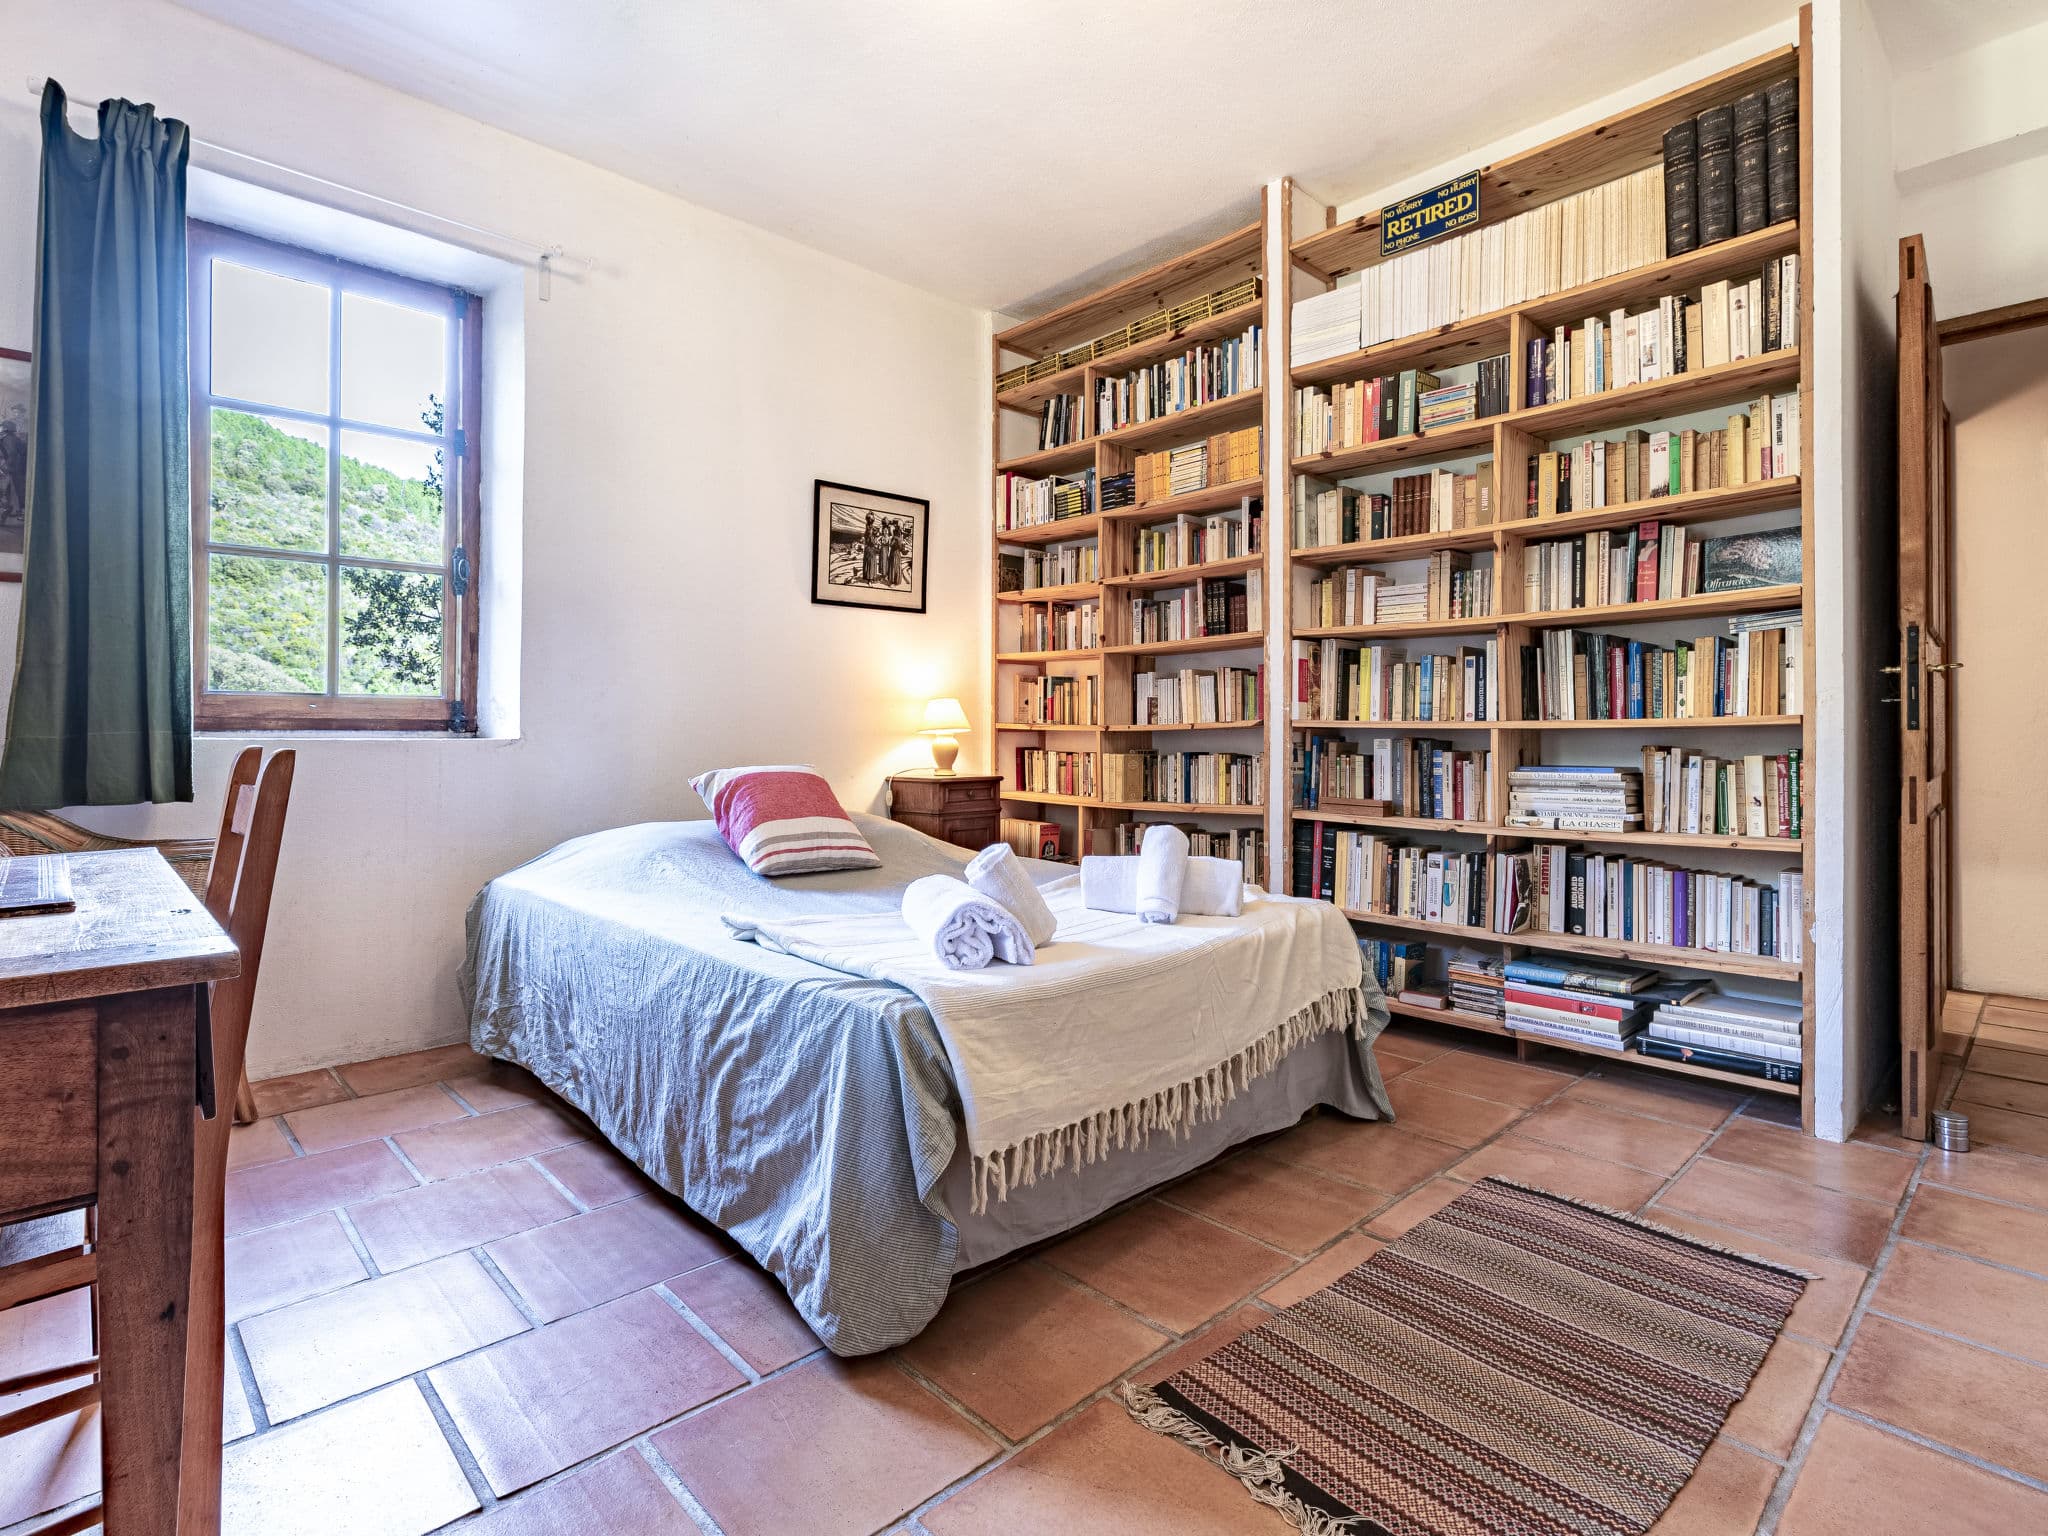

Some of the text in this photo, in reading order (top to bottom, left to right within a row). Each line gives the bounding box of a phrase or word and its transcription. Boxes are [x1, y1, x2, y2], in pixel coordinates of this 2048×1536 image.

[1437, 176, 1477, 199] NO HURRY
[1384, 199, 1423, 220] NO WORRY
[1386, 192, 1473, 239] RETIRED
[1445, 211, 1477, 229] NO BOSS
[1384, 232, 1421, 250] NO PHONE
[1790, 762, 1799, 830] l'apiculture aujourd'hui
[1562, 819, 1621, 829] LA CHASSE
[1559, 1015, 1591, 1026] COLLECTIONS
